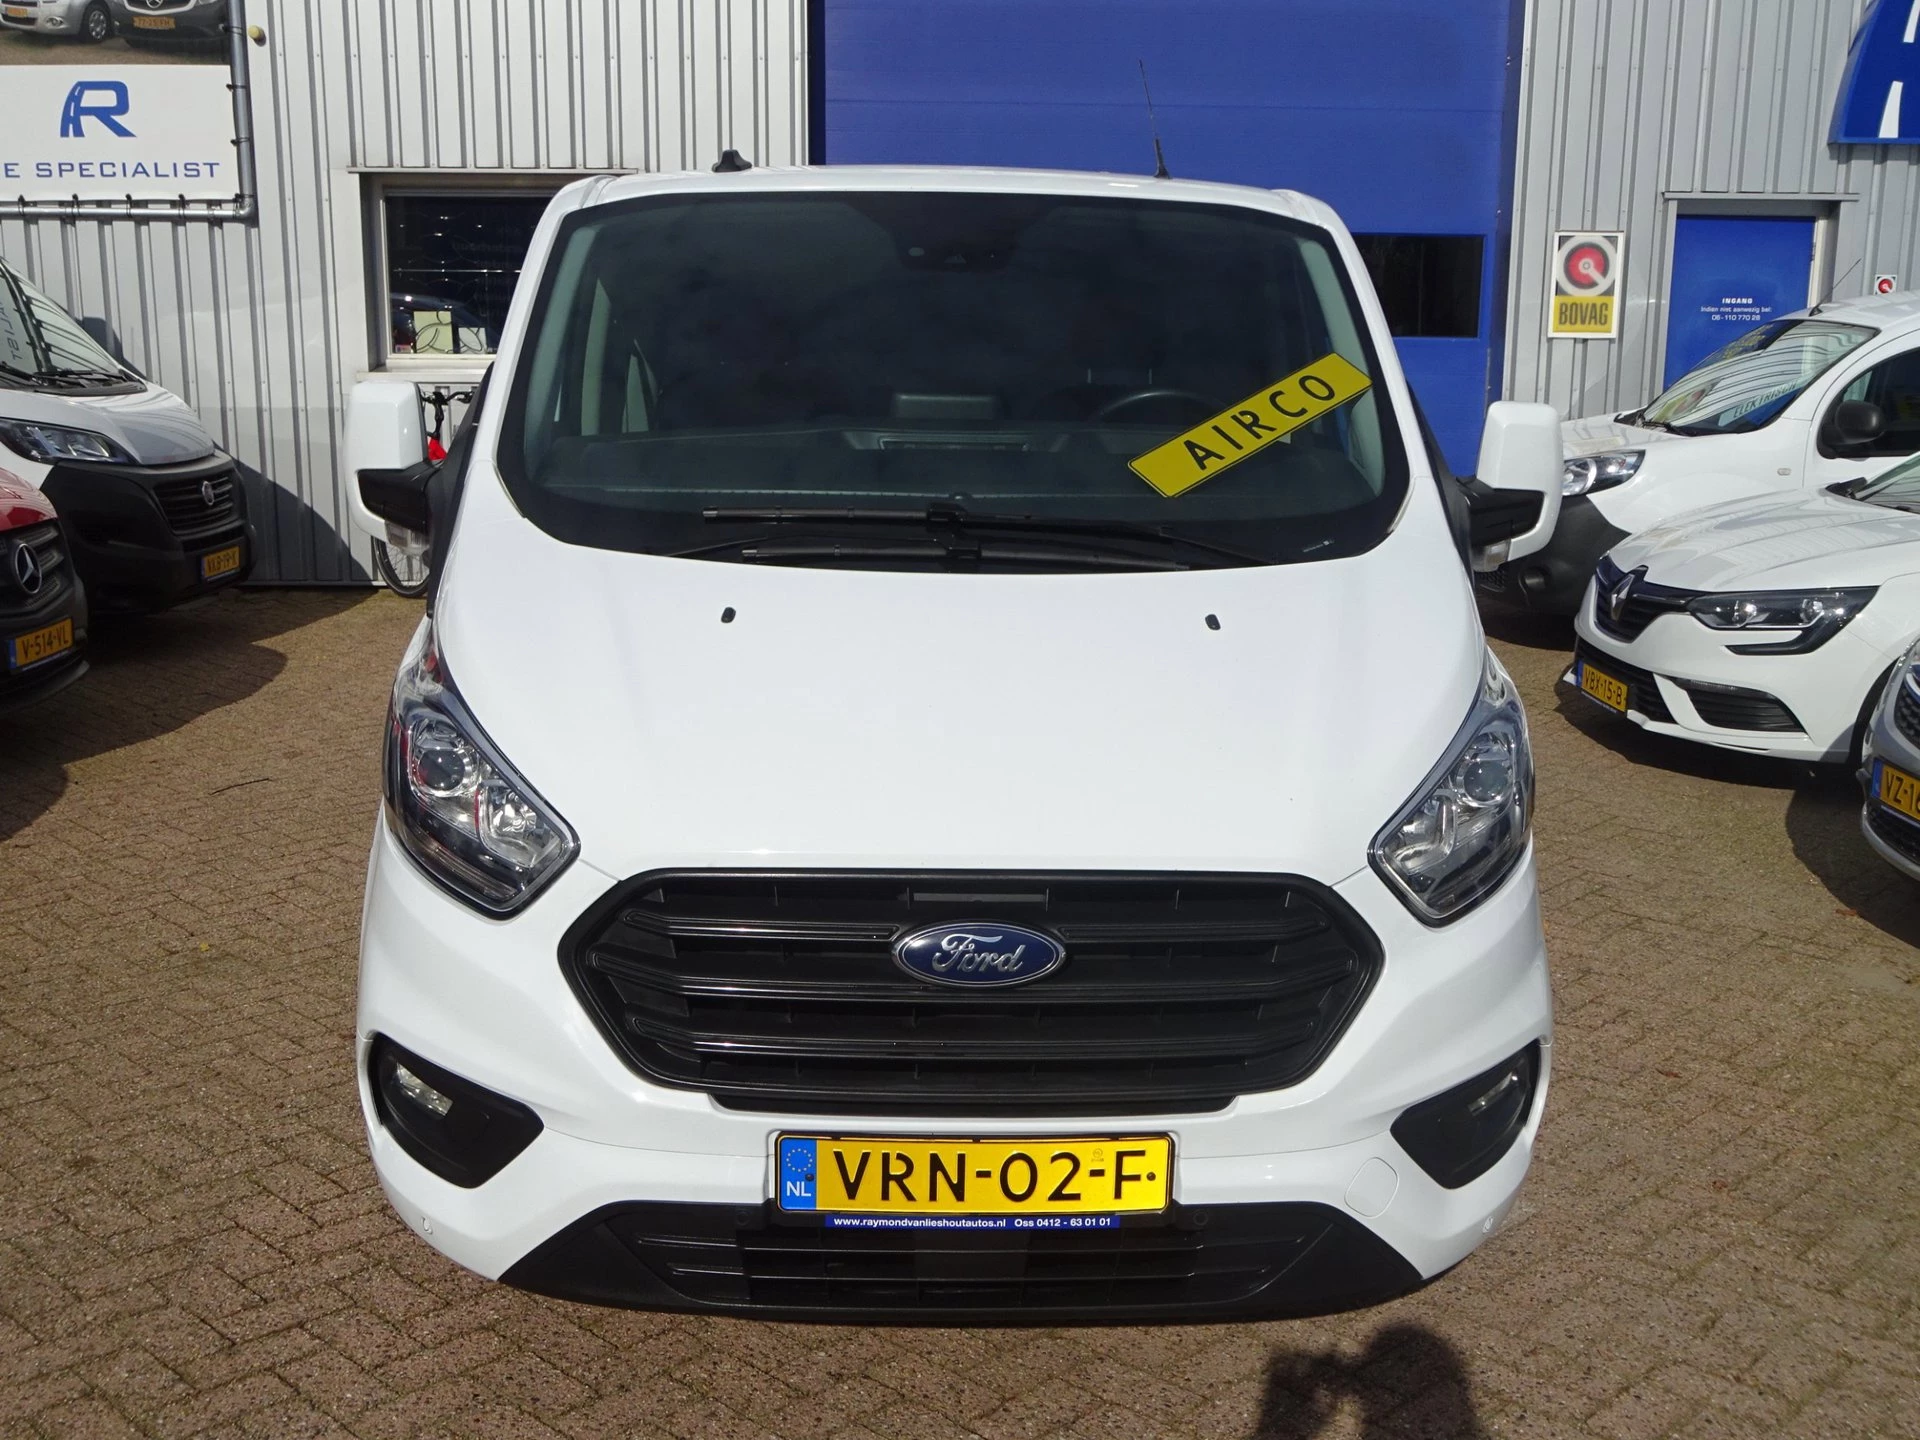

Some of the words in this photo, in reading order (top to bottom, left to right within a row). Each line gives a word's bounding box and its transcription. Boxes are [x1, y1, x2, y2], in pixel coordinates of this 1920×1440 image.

[36, 162, 220, 178] SPECIALIST
[1558, 302, 1609, 326] BOVAG
[1721, 297, 1753, 305] INGANG
[1183, 374, 1336, 471] AIRCO
[21, 624, 70, 660] V-514-VL
[1584, 667, 1623, 706] VBX-15-B
[932, 933, 1027, 973] Ford
[786, 1181, 812, 1197] NL
[833, 1149, 1147, 1203] VRN-02-F
[833, 1216, 1006, 1230] www.raymondvanlieshoutautos.nl
[1014, 1217, 1034, 1228] Oss
[1036, 1216, 1061, 1227] 0412
[1070, 1216, 1083, 1227] 63
[1084, 1216, 1096, 1227] 01
[1099, 1216, 1111, 1227] 01
